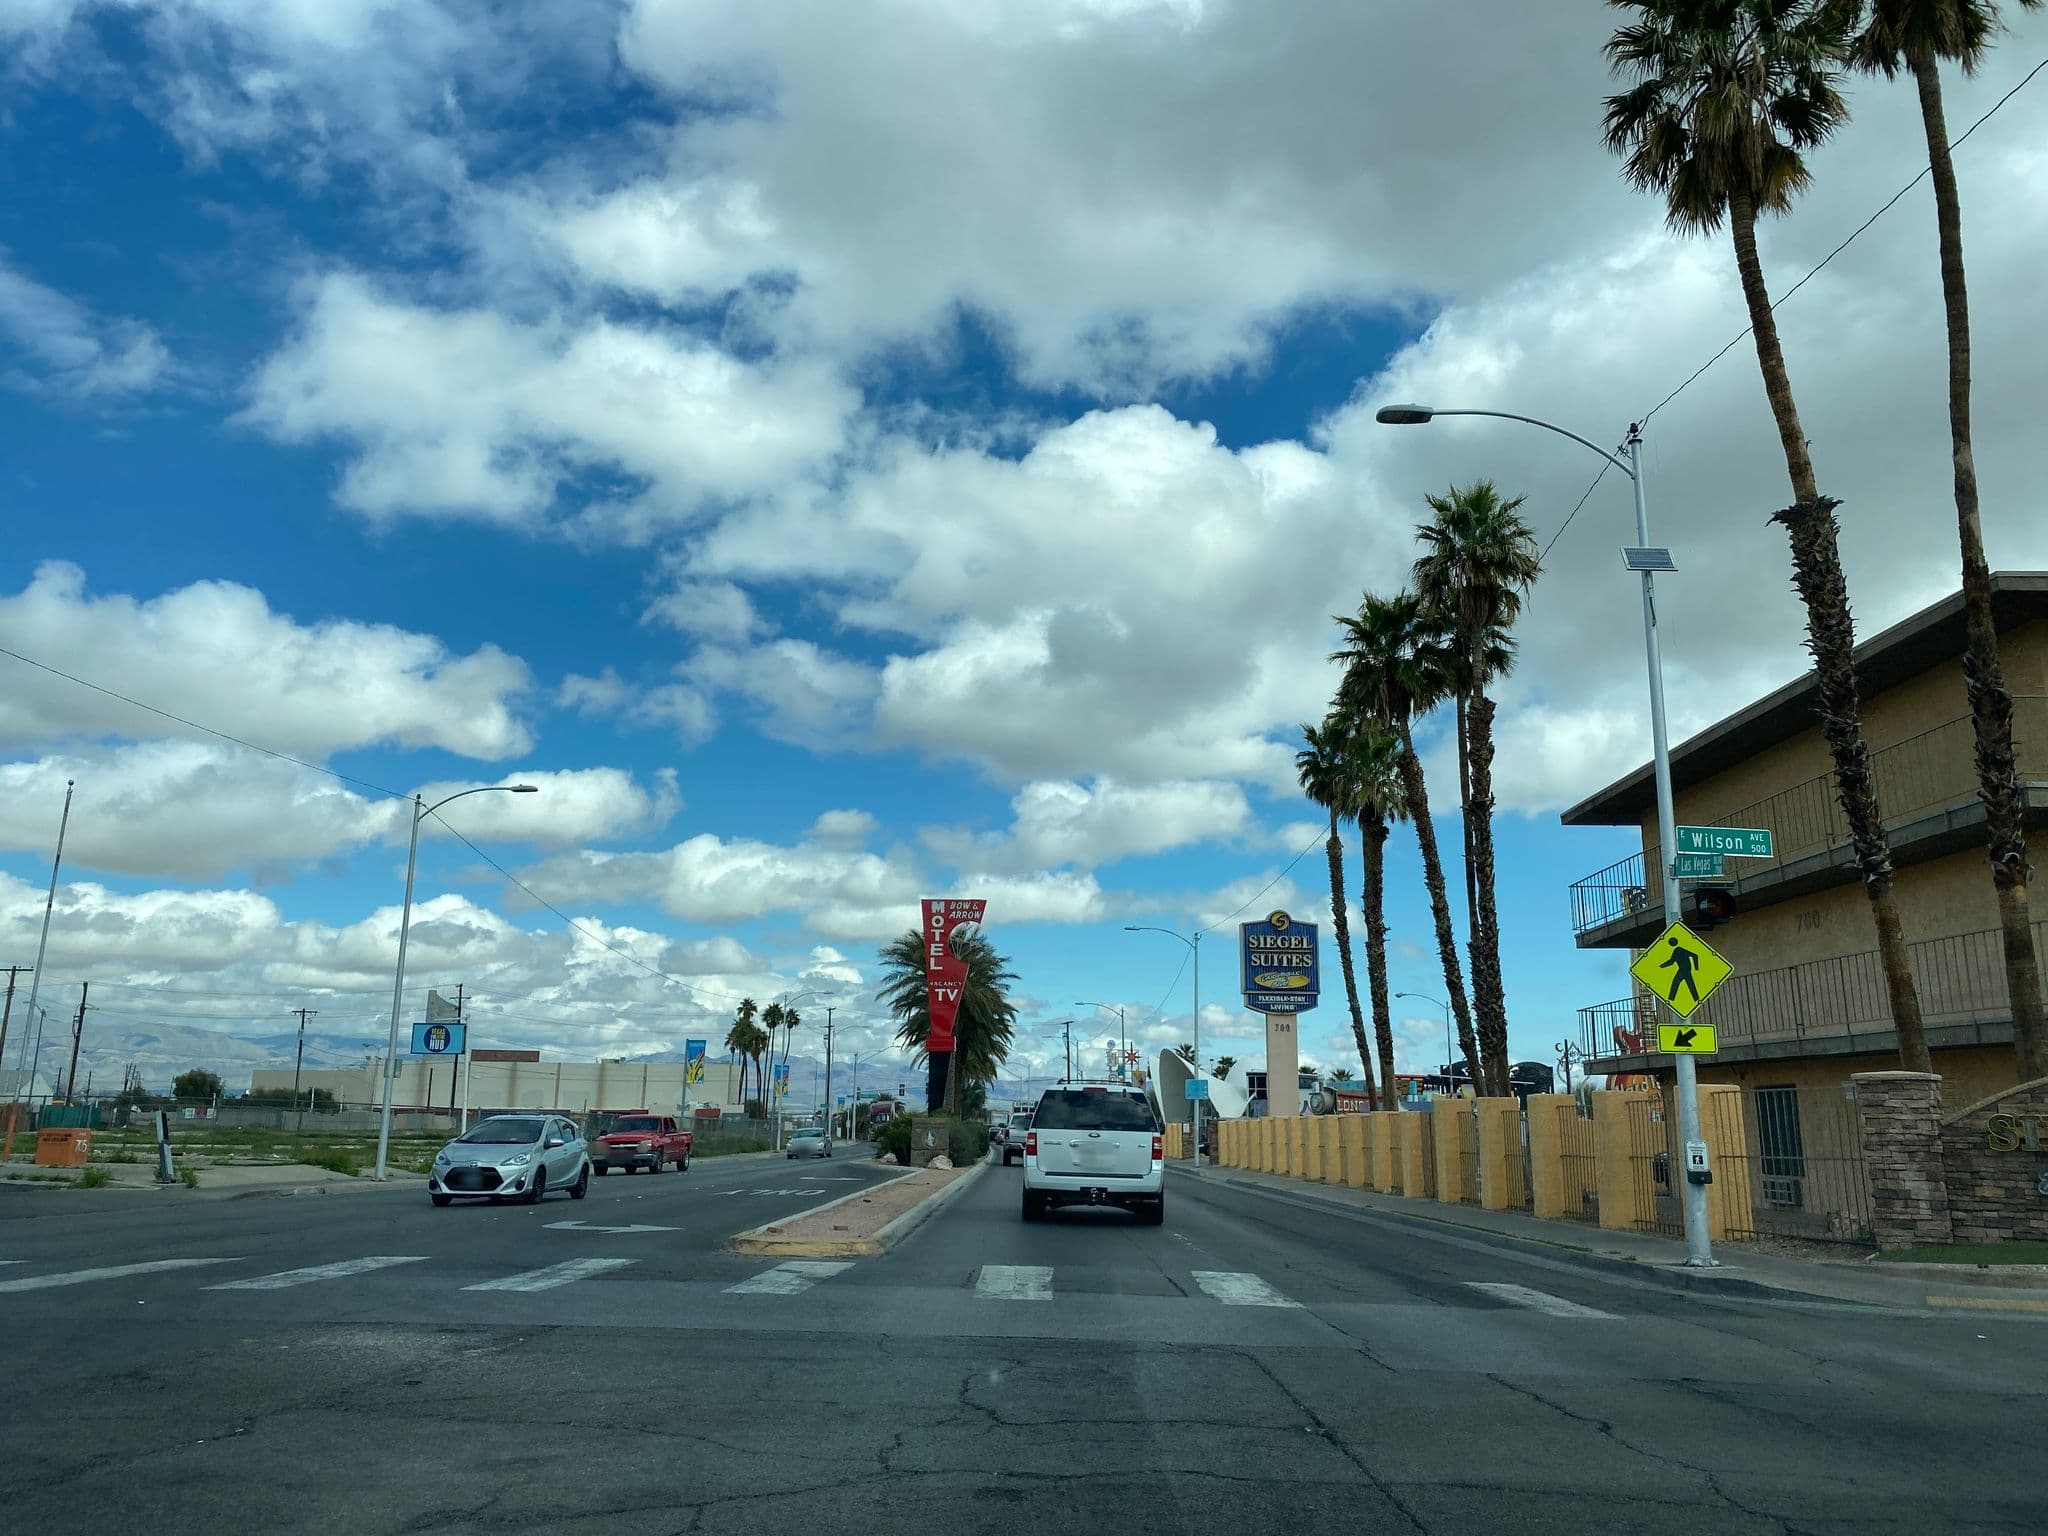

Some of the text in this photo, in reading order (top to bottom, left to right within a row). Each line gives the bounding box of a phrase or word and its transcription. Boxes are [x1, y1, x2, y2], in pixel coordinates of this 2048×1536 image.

[1680, 829, 1764, 850] E Wilson AVE
[1751, 844, 1767, 853] 500
[1681, 856, 1692, 872] Las
[1693, 855, 1711, 874] Vegas
[949, 902, 971, 910] BOW
[948, 911, 982, 919] ARROW
[930, 901, 945, 970] MOTEL
[1248, 934, 1313, 949] SIEGEL
[1251, 953, 1313, 967] SUITES
[934, 988, 959, 1002] TV
[1270, 1003, 1295, 1011] LIVING
[1274, 1024, 1291, 1033] 700
[429, 1039, 446, 1050] HUB
[1988, 1113, 2048, 1152] SI
